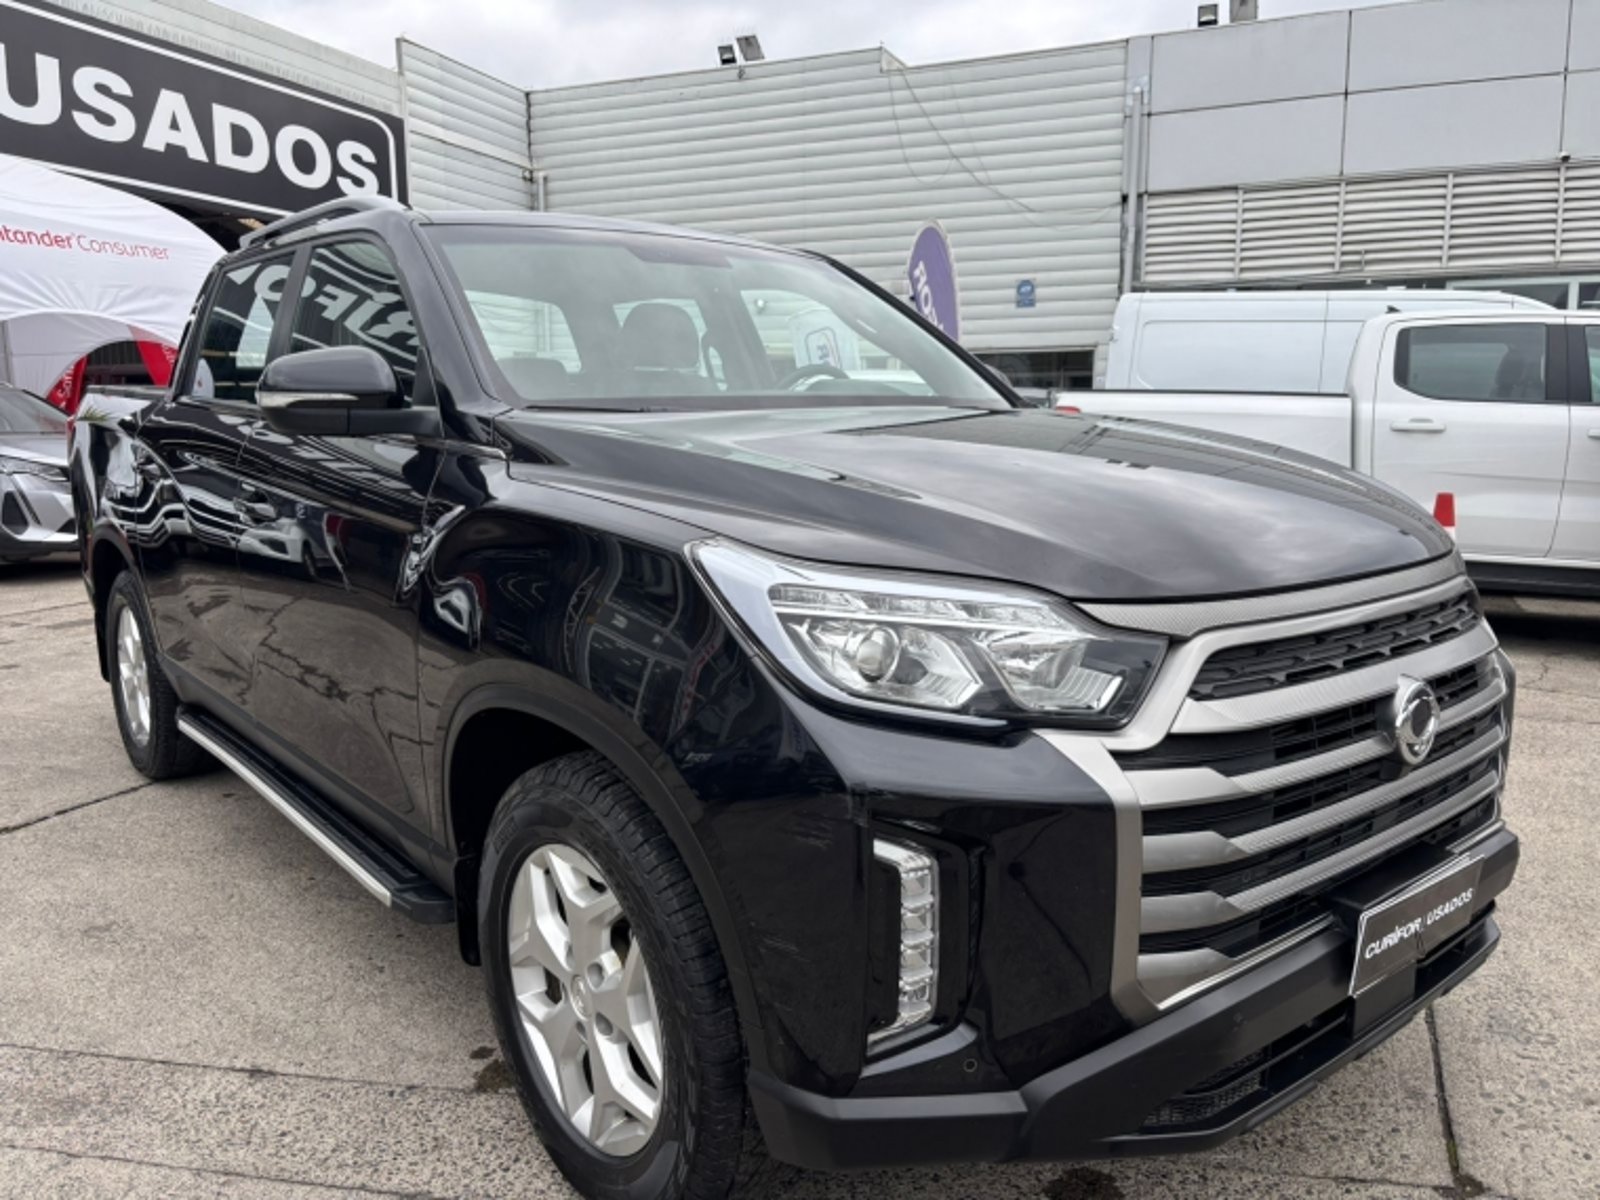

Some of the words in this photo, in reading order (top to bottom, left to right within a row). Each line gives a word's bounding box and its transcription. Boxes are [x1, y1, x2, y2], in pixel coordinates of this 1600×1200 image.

[0, 42, 380, 197] USADOS
[77, 235, 169, 260] Consumer
[1426, 887, 1474, 925] USADOS
